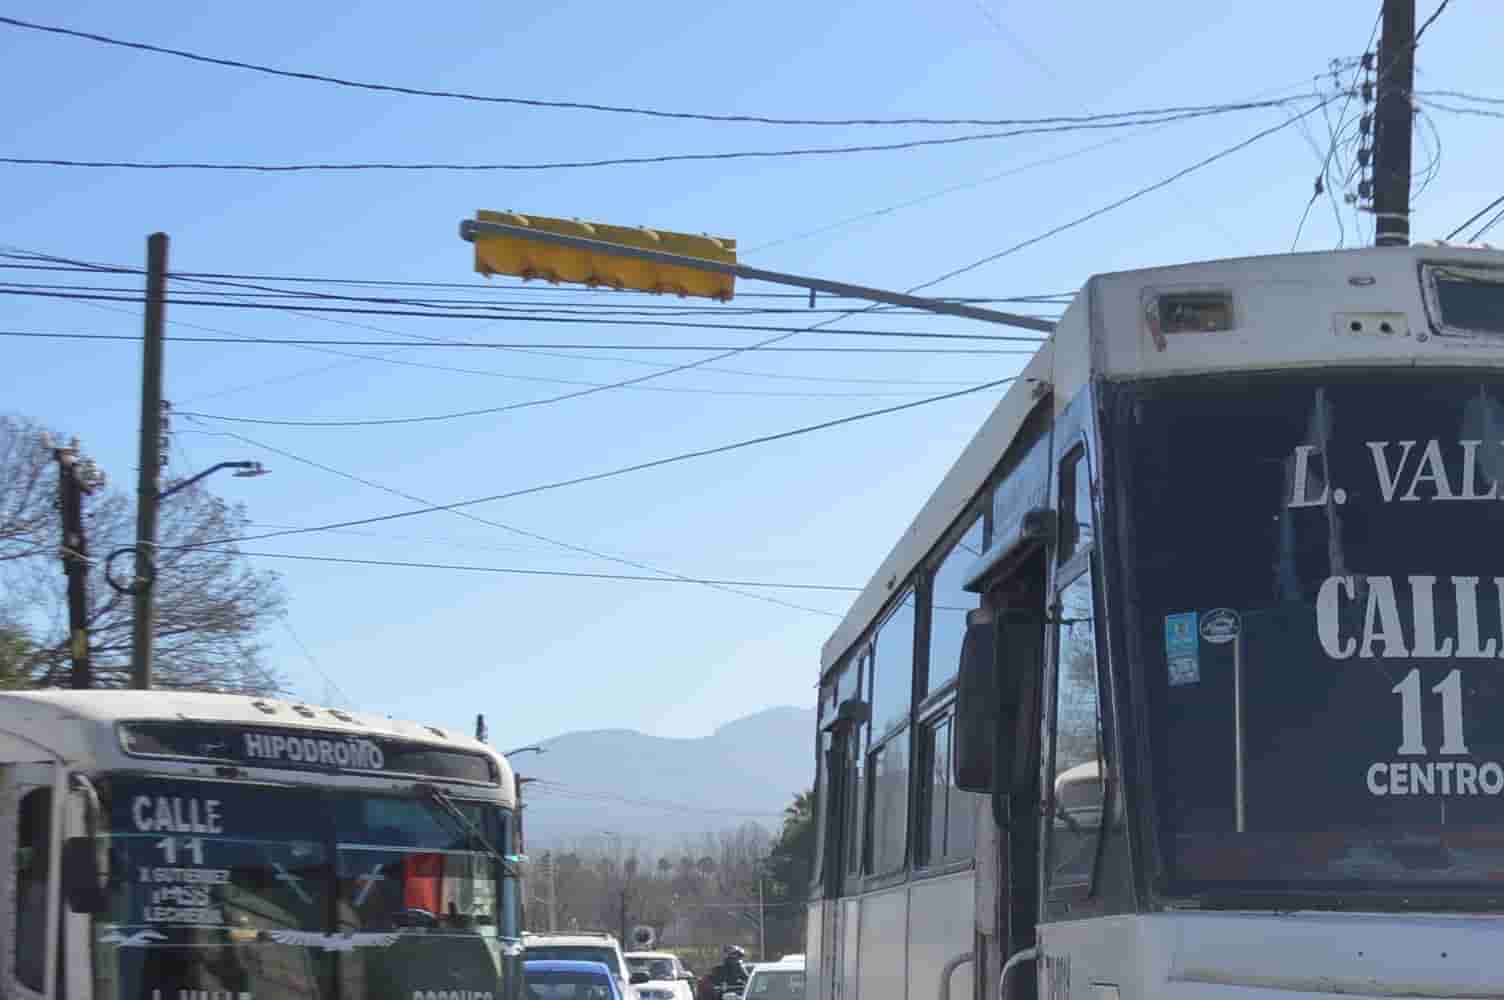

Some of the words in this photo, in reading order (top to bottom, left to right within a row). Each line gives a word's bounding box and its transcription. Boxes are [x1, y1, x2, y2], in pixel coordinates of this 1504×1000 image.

[1287, 444, 1347, 508] L.
[1391, 668, 1470, 756] 11
[243, 733, 385, 769] HIPODROMO
[1366, 761, 1504, 796] CENTRO
[132, 795, 224, 834] CALLE
[155, 836, 204, 865] 11
